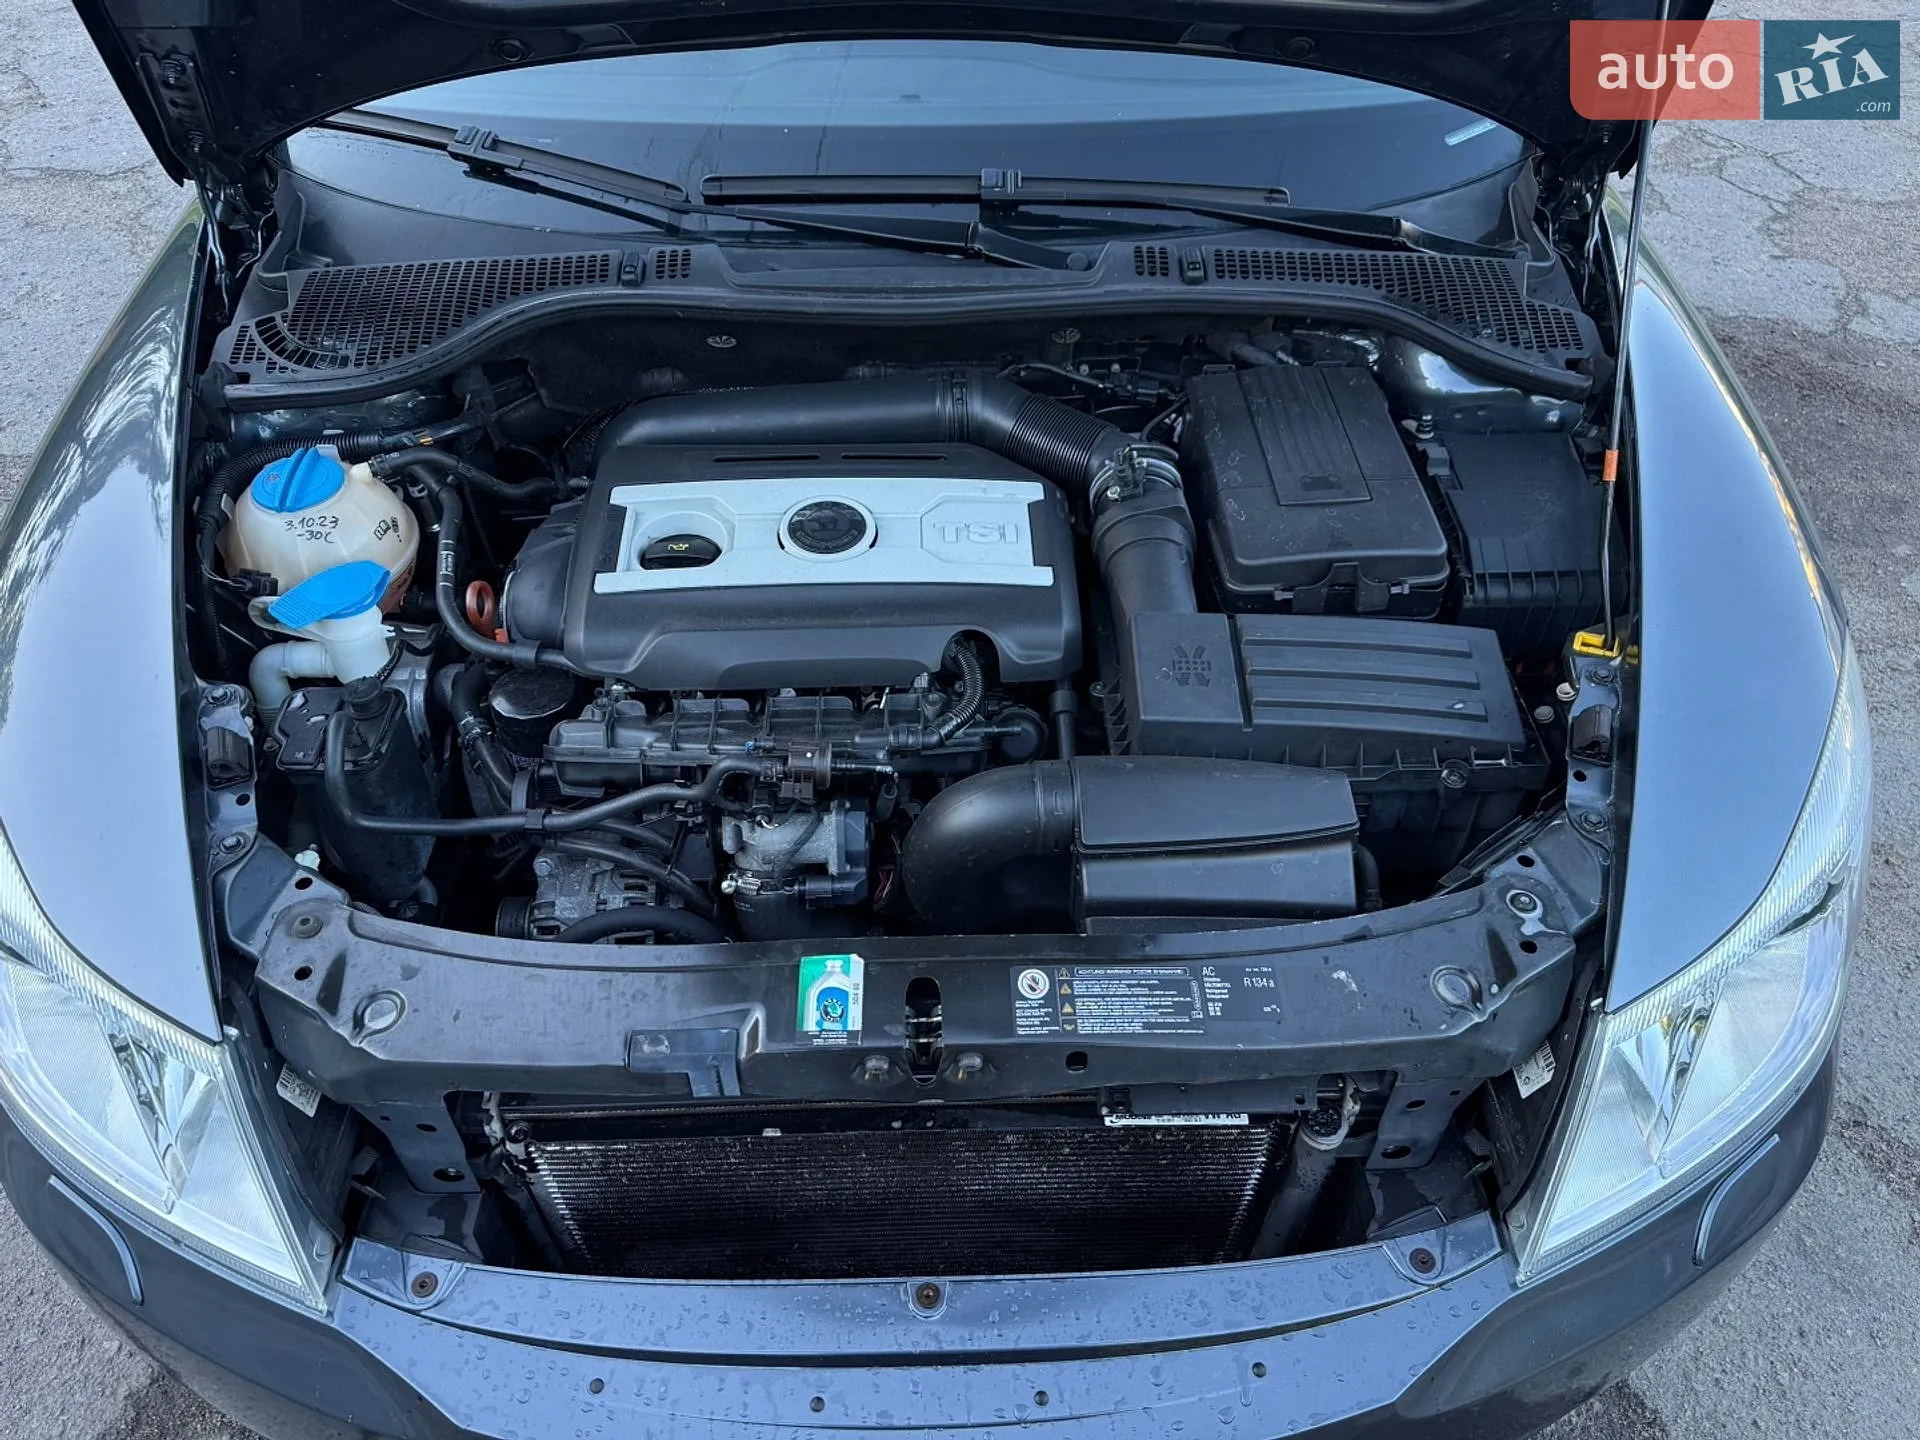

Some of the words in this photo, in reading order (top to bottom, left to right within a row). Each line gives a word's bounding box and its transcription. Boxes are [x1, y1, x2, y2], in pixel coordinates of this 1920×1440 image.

[284, 515, 340, 531] 3.10.23
[933, 521, 1019, 545] TSI
[1202, 966, 1215, 976] AC
